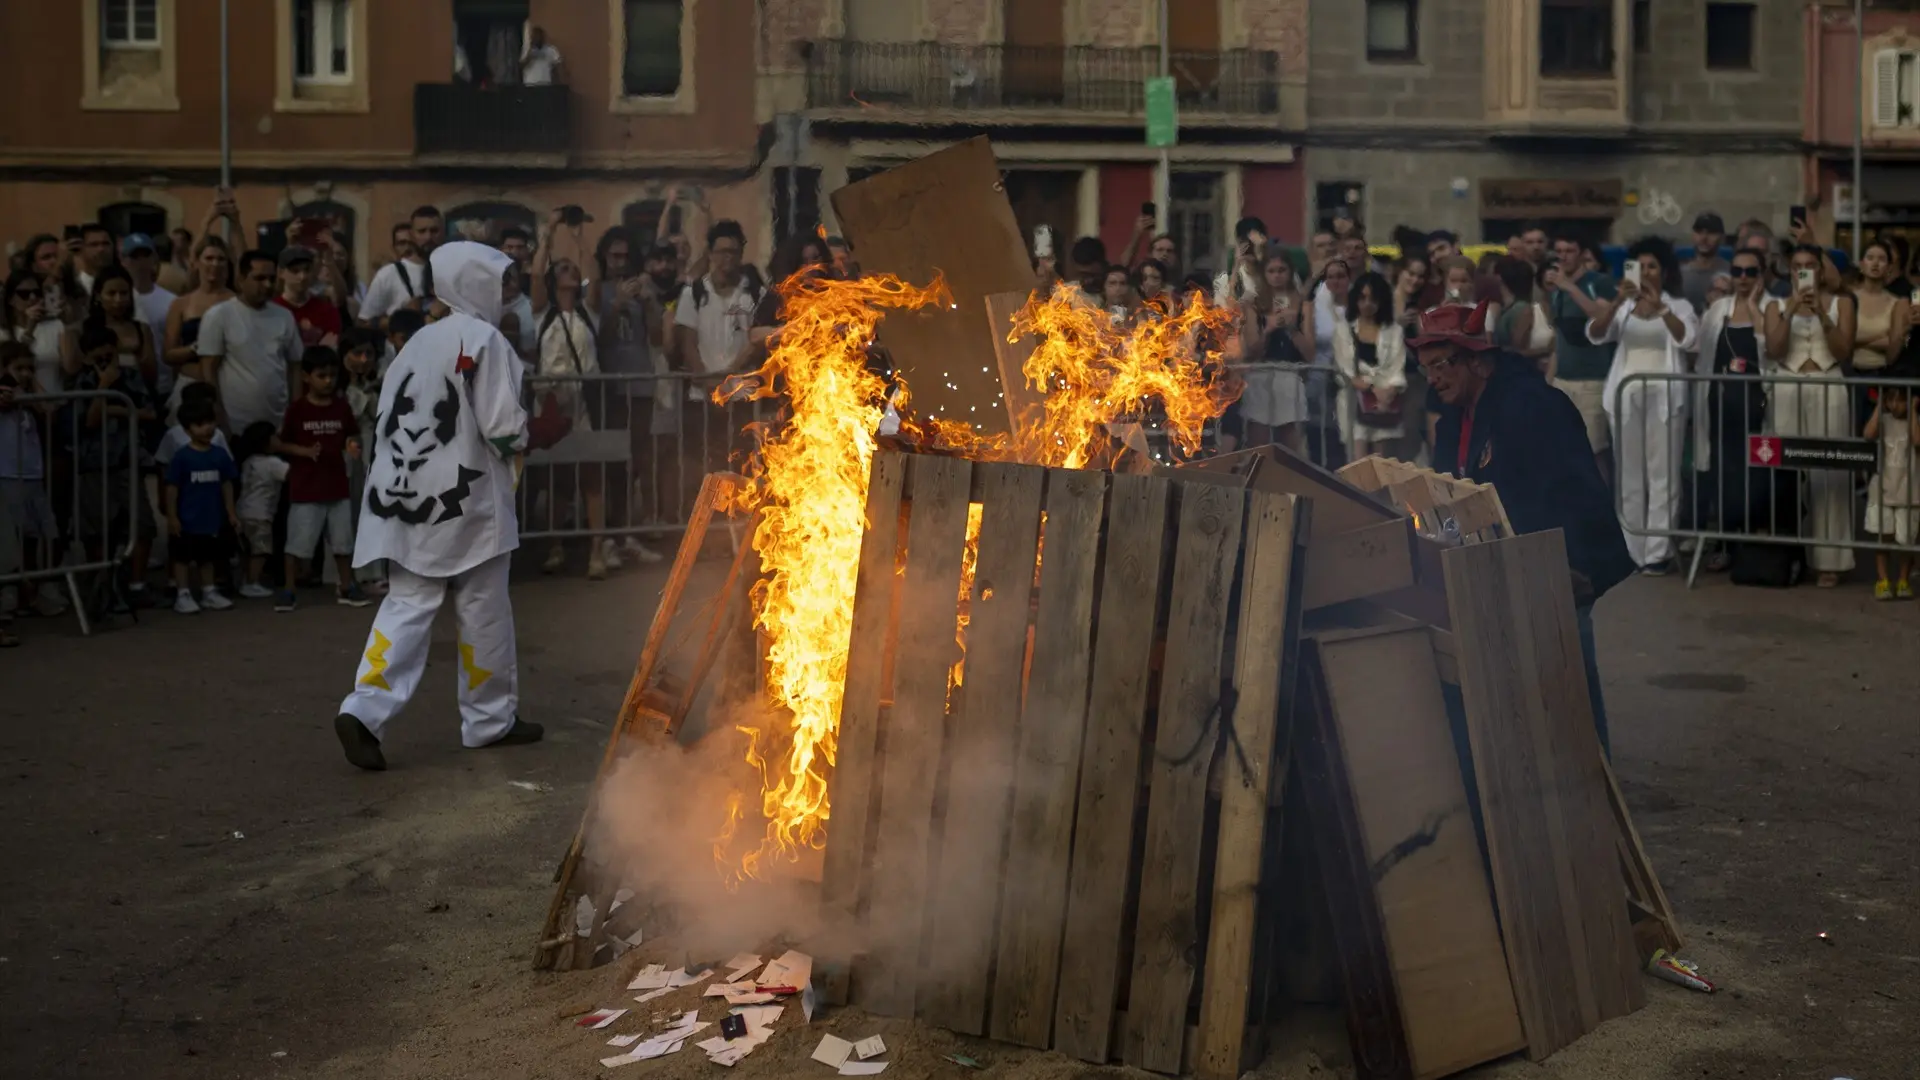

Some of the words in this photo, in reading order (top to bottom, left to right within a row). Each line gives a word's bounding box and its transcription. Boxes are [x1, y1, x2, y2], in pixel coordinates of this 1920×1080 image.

[1784, 448, 1825, 458] Ajuntament
[1826, 450, 1835, 459] de
[1836, 450, 1874, 461] Barcelona
